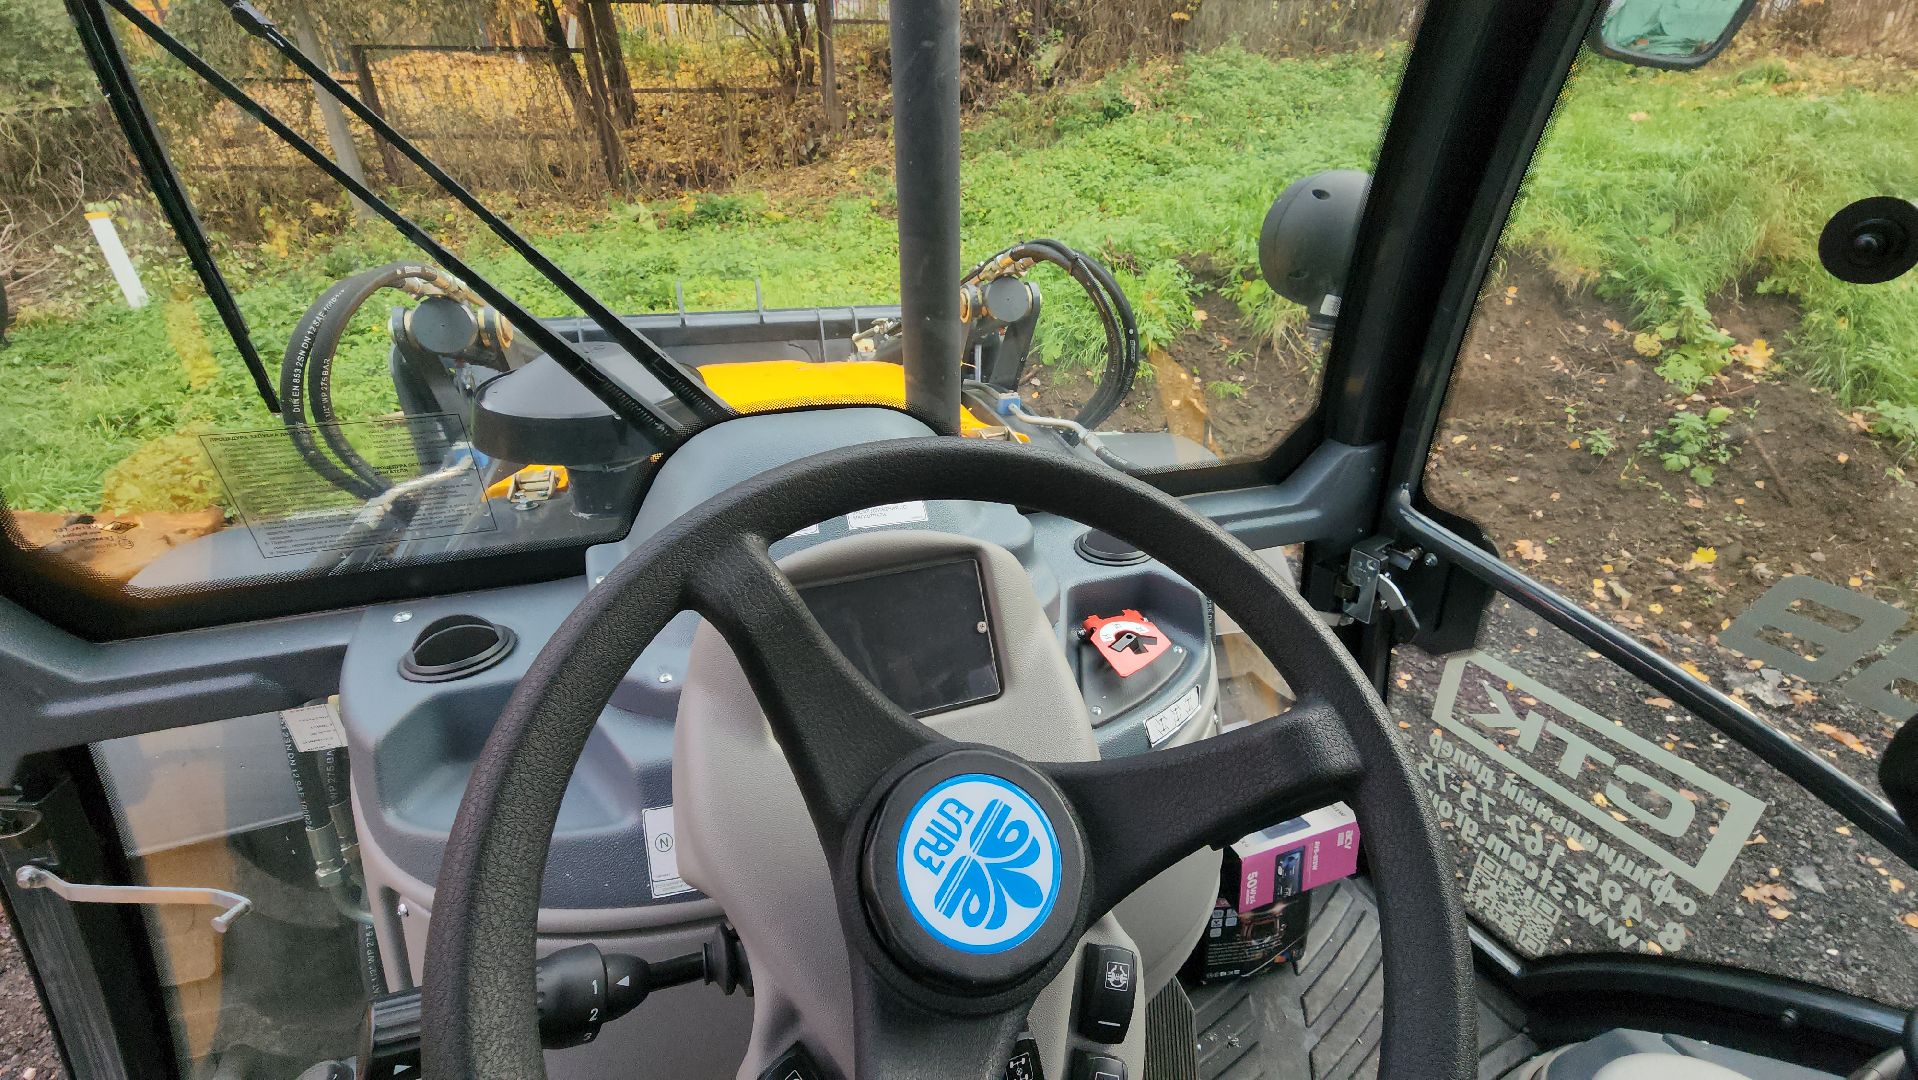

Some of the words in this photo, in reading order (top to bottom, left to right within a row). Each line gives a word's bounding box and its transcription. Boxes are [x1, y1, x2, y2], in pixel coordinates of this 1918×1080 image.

[312, 312, 327, 327] SAE
[301, 335, 312, 349] DN
[295, 350, 306, 368] 2SN
[292, 368, 302, 383] 853
[292, 385, 300, 397] EN
[321, 391, 328, 405] WP
[292, 398, 301, 413] DIN
[659, 837, 669, 849] N
[591, 979, 598, 995] 1
[588, 1007, 599, 1022] 2
